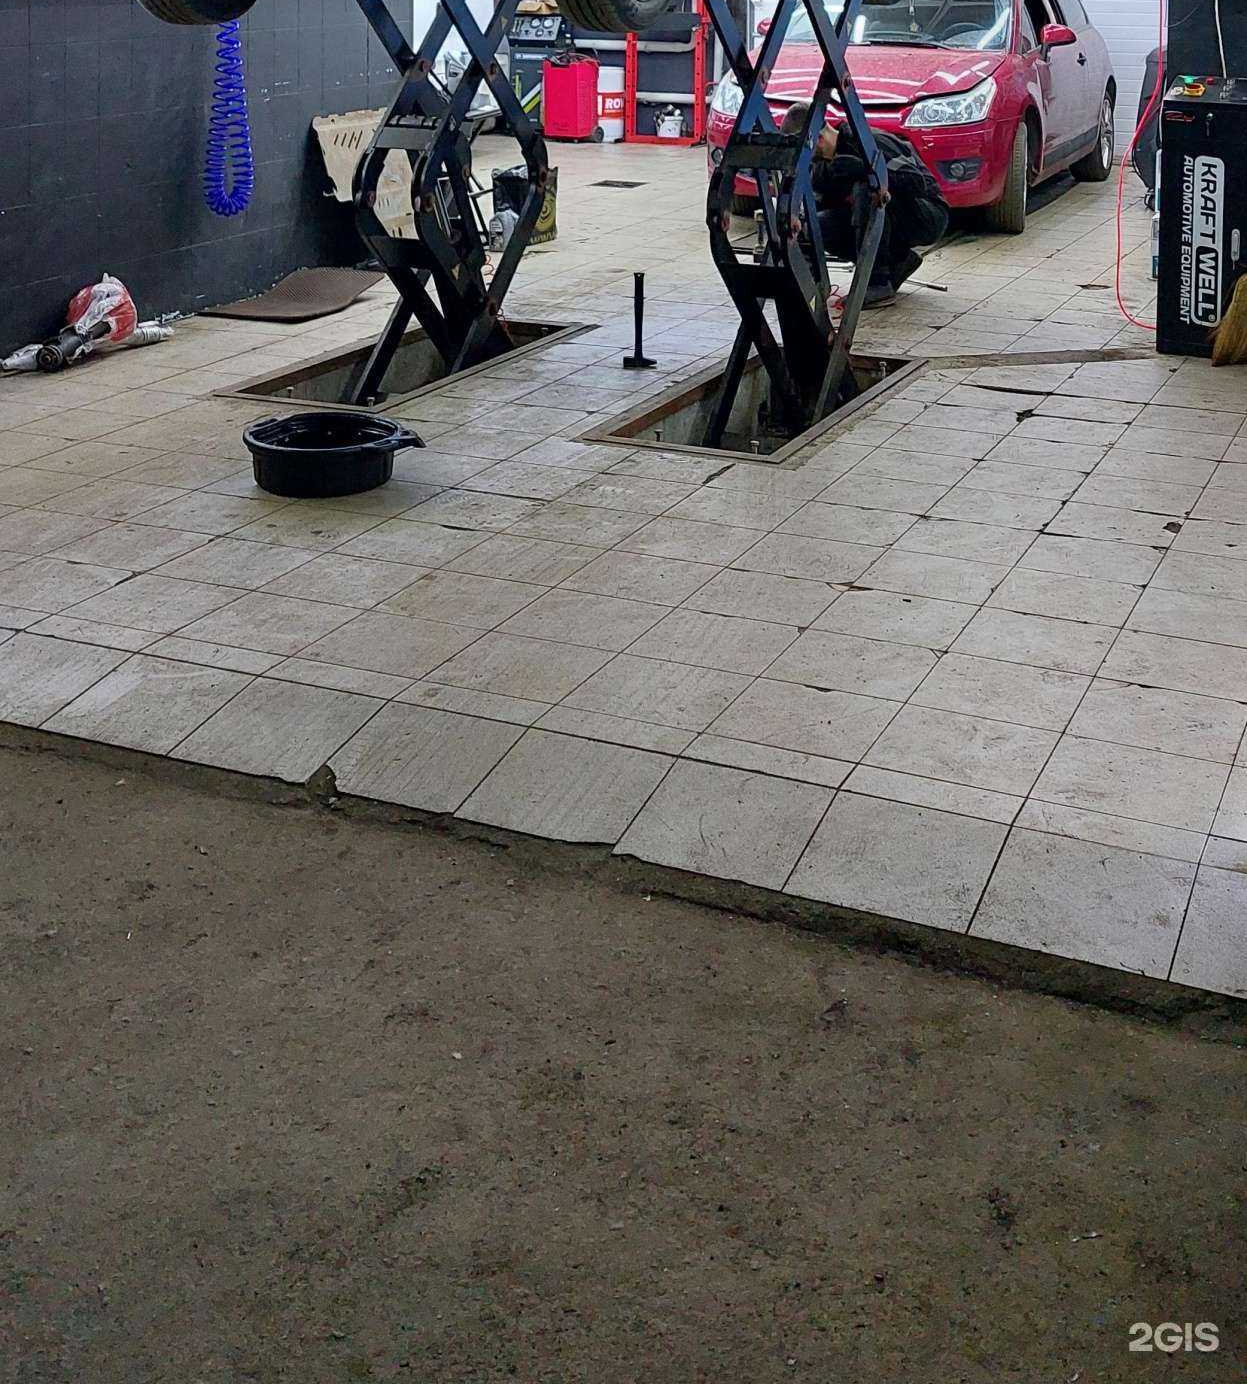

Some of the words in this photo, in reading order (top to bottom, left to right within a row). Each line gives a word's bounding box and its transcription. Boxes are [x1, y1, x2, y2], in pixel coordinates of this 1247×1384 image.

[1181, 154, 1194, 244] AUTOMOTIVE
[1199, 161, 1218, 245] KRAFT
[1179, 245, 1192, 325] EQUIPMENT
